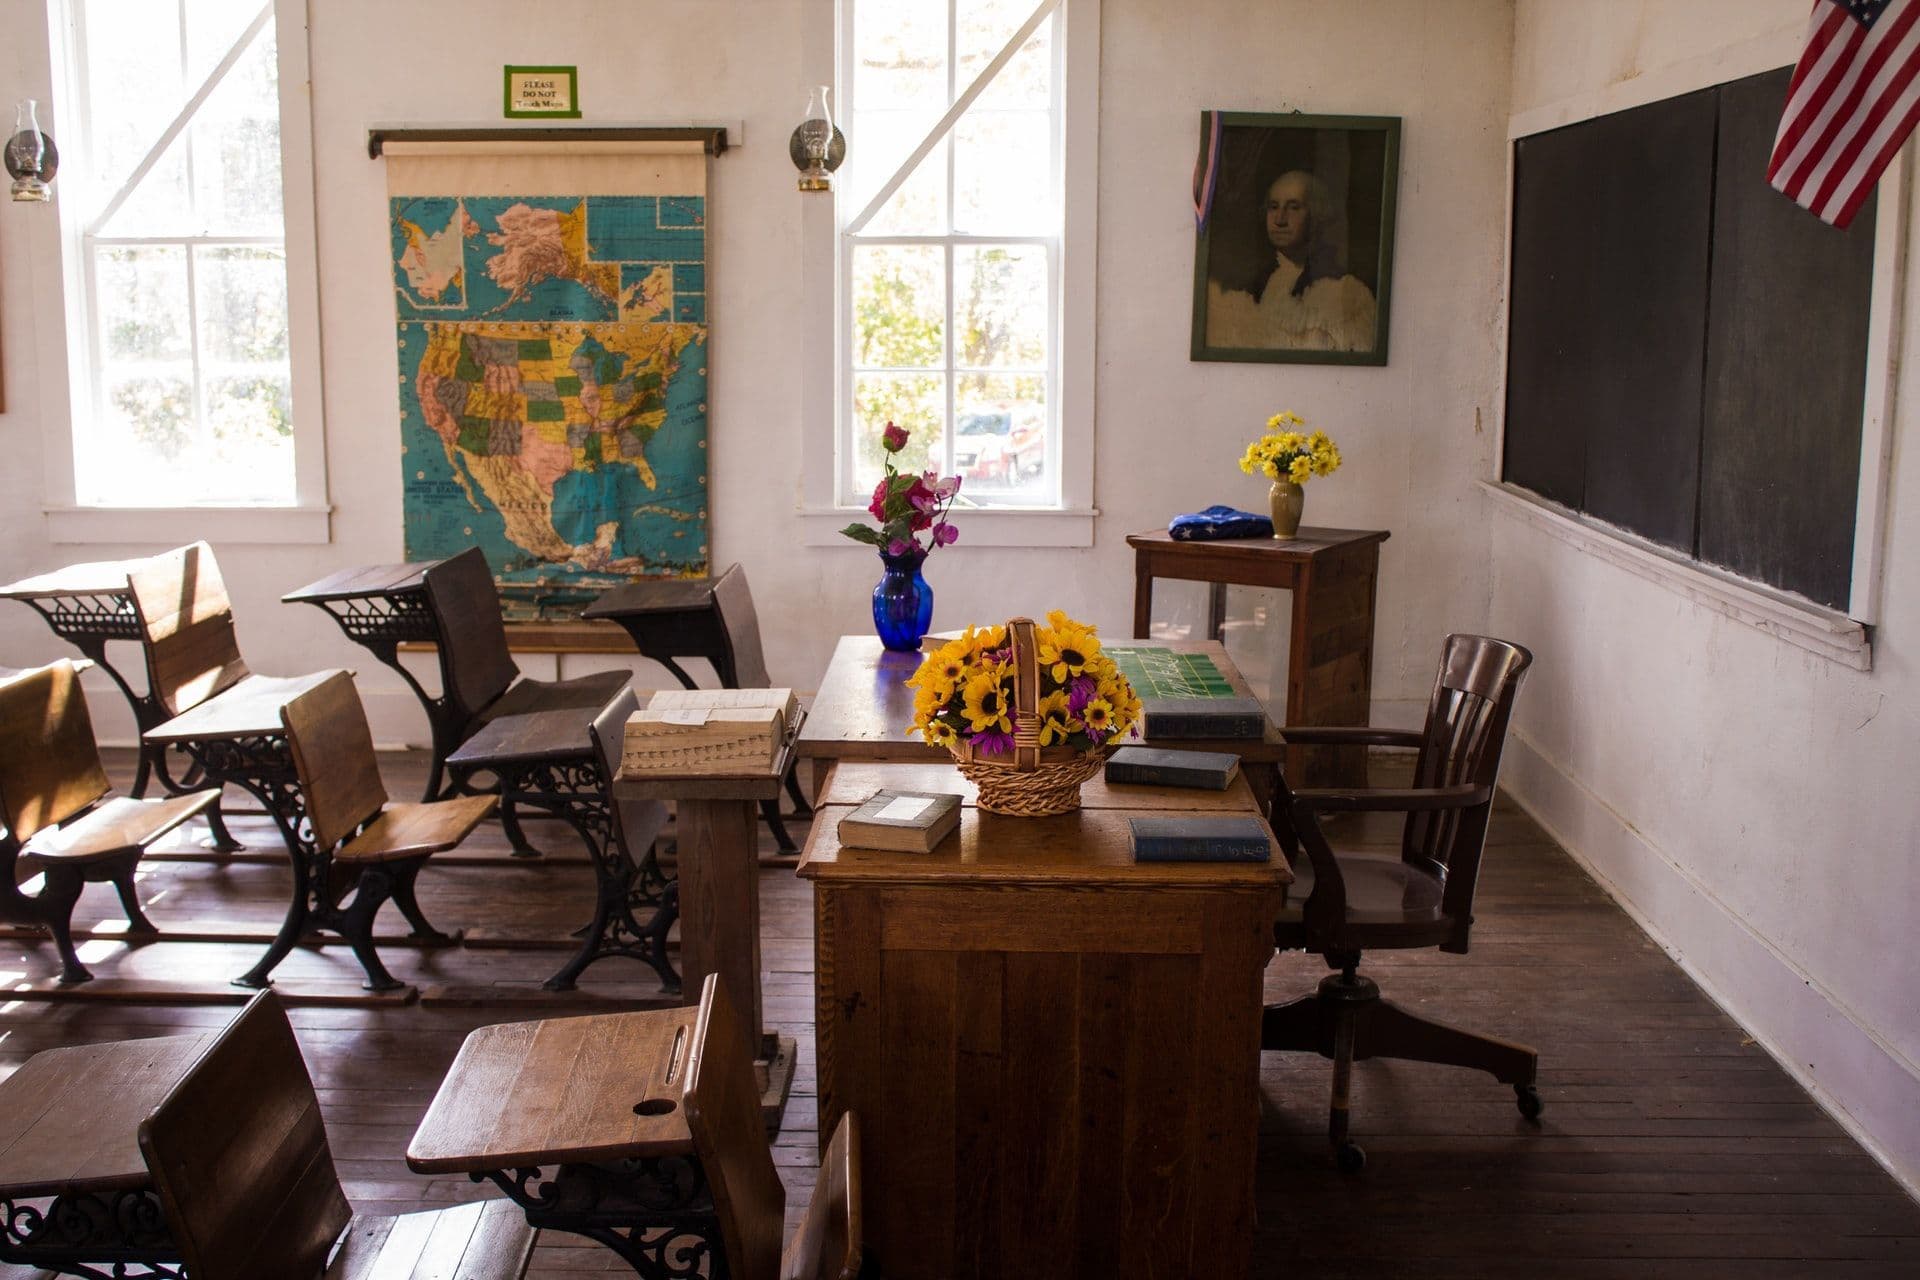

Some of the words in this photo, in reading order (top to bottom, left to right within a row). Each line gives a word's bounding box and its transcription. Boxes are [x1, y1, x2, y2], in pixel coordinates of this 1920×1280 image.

[522, 90, 536, 98] DO
[537, 90, 557, 98] NOT
[499, 501, 547, 511] MEXICO
